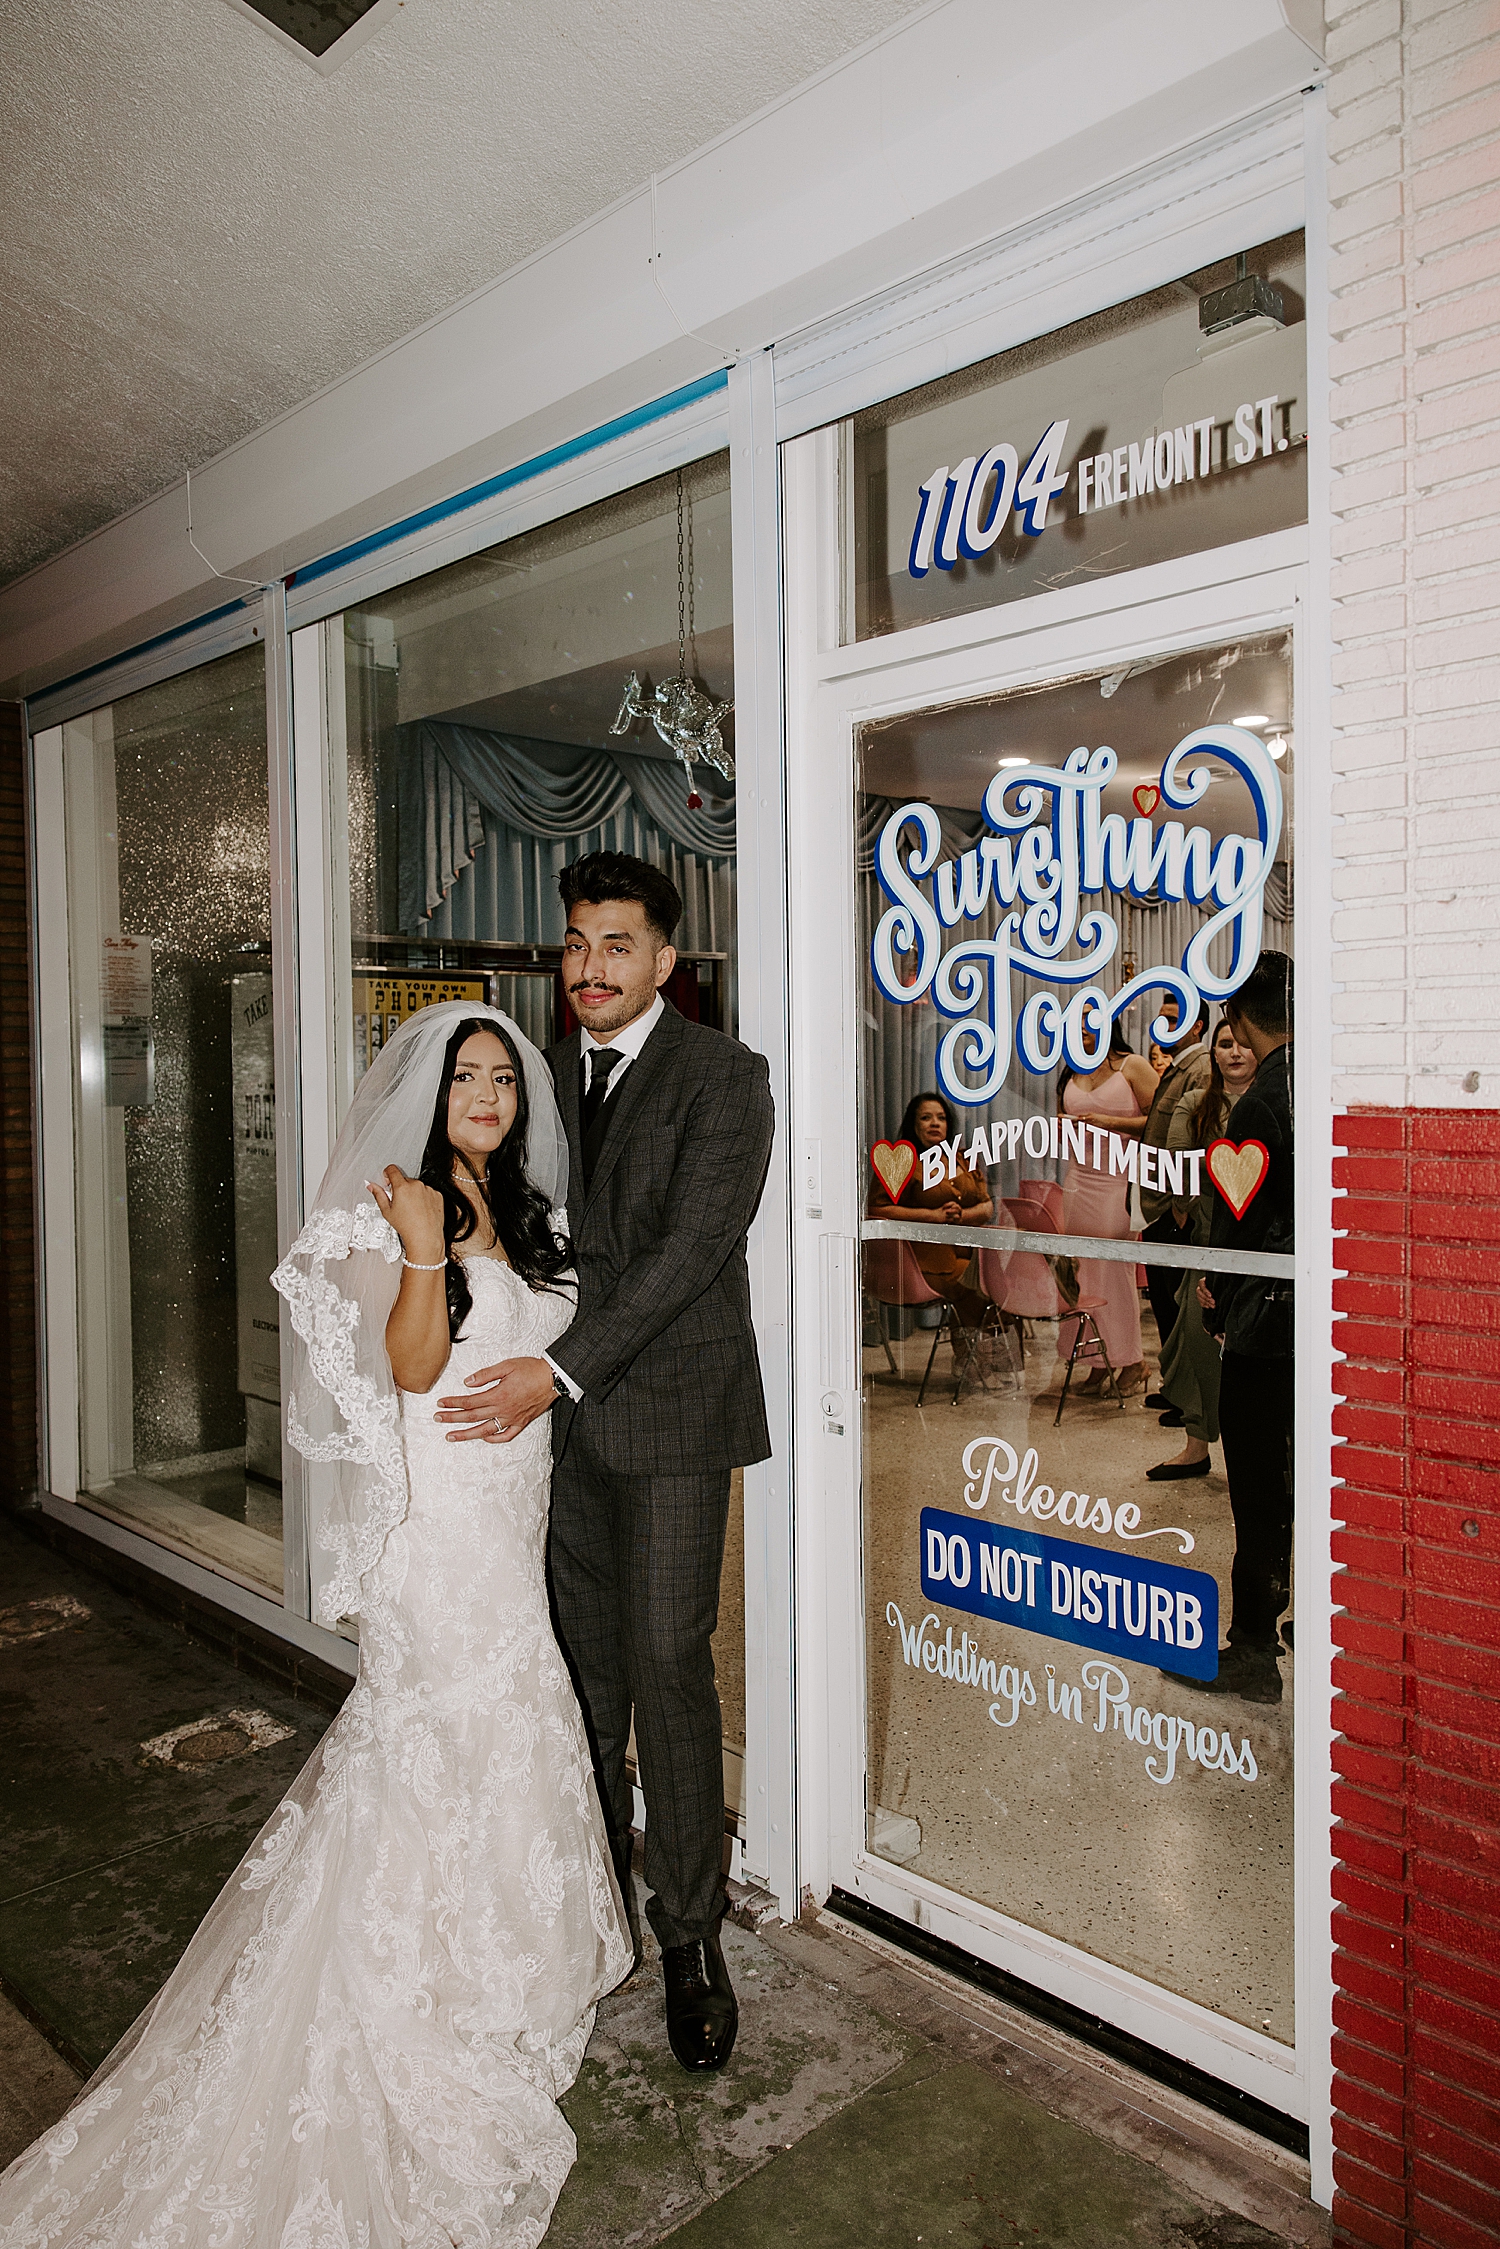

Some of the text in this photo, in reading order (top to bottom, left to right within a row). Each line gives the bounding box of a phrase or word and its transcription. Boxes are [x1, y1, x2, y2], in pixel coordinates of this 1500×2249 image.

[909, 395, 1289, 578] 1104 FREMONT ST.
[871, 724, 1283, 1004] Sure Thing
[244, 994, 269, 1027] TAKE
[369, 981, 467, 993] TAKE YOUR OWN
[931, 911, 1200, 1107] Too
[920, 1115, 1206, 1196] BY APPOINTMENT
[962, 1436, 1195, 1554] Please
[926, 1528, 1204, 1650] DO NOT DISTURB
[886, 1601, 1258, 1784] Weddings in Progress
